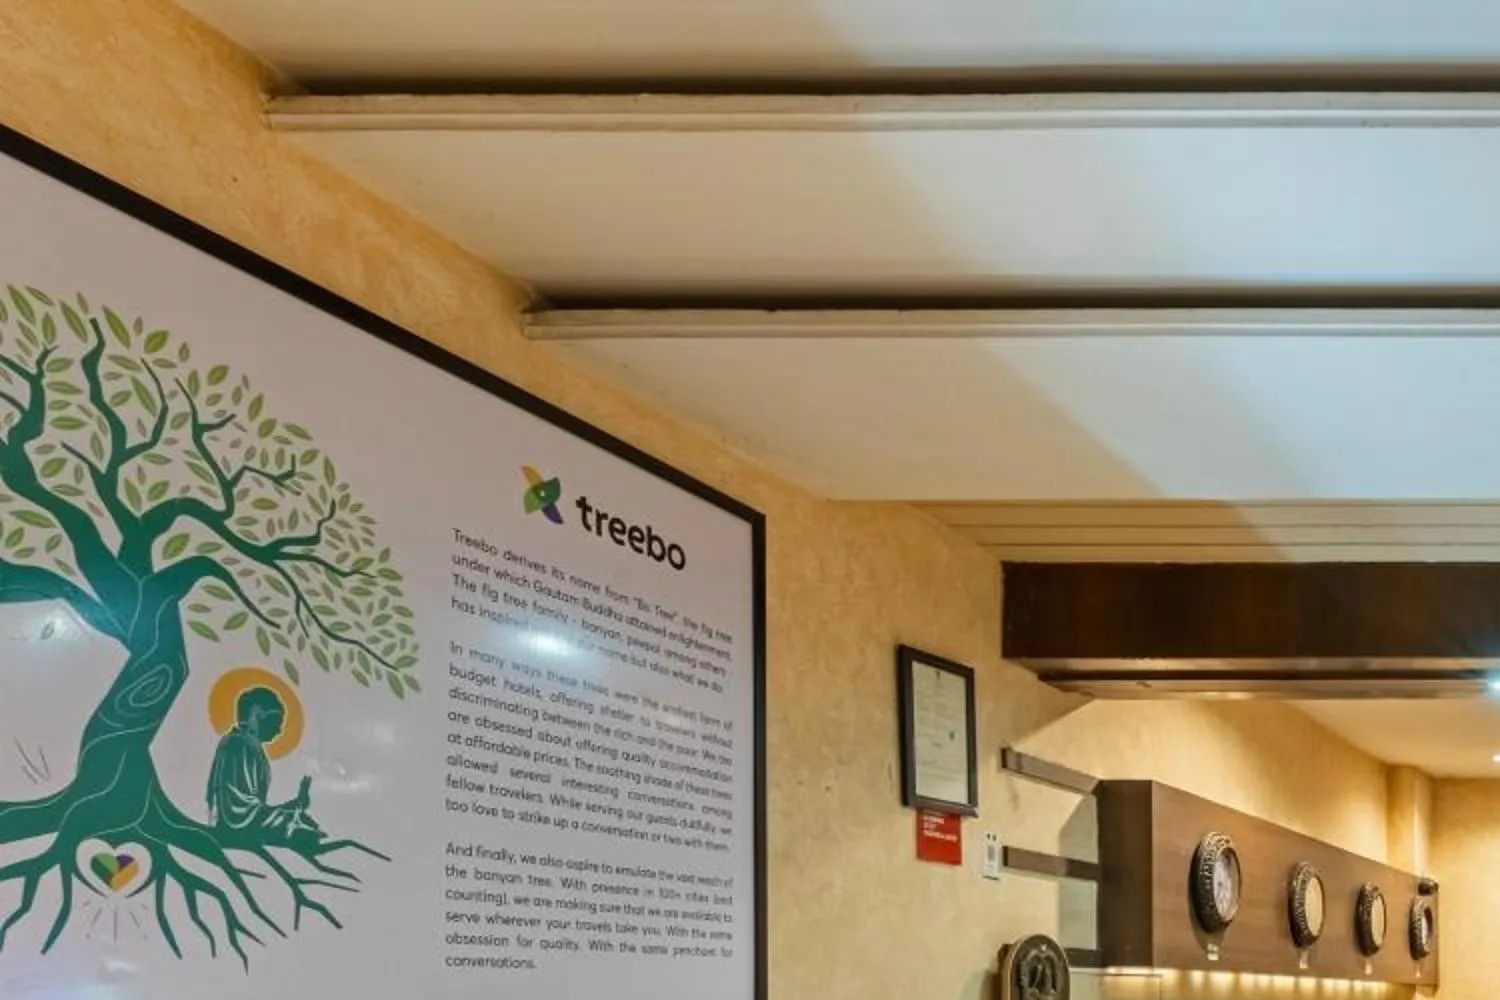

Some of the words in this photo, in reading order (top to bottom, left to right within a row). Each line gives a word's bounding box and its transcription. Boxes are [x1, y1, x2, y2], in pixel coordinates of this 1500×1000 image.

[575, 496, 687, 571] treebo
[451, 549, 490, 576] under
[494, 565, 530, 590] which
[452, 573, 476, 594] The
[482, 583, 499, 604] fig
[451, 595, 475, 615] has
[450, 639, 462, 656] In
[448, 662, 496, 691] budget
[448, 685, 538, 723] discriminating
[447, 709, 470, 725] are
[474, 713, 532, 739] obsessed
[537, 728, 571, 747] about
[447, 729, 461, 745] at
[465, 733, 530, 759] affordable
[447, 751, 498, 774] allowed
[446, 774, 485, 794] fellow
[445, 797, 468, 813] too
[472, 801, 498, 818] love
[501, 806, 515, 820] to
[519, 808, 550, 826] strike
[553, 816, 568, 831] up
[571, 819, 579, 830] a
[445, 841, 472, 857] And
[519, 853, 536, 865] we
[538, 852, 563, 868] also
[601, 860, 613, 873] to
[445, 863, 467, 879] the
[473, 866, 522, 887] banyan
[559, 876, 586, 891] With
[513, 894, 530, 906] we
[532, 896, 552, 908] are
[555, 895, 596, 914] making
[445, 910, 480, 924] serve
[485, 911, 541, 927] wherever
[545, 918, 570, 932] your
[444, 930, 509, 946] obsession
[516, 934, 533, 947] for
